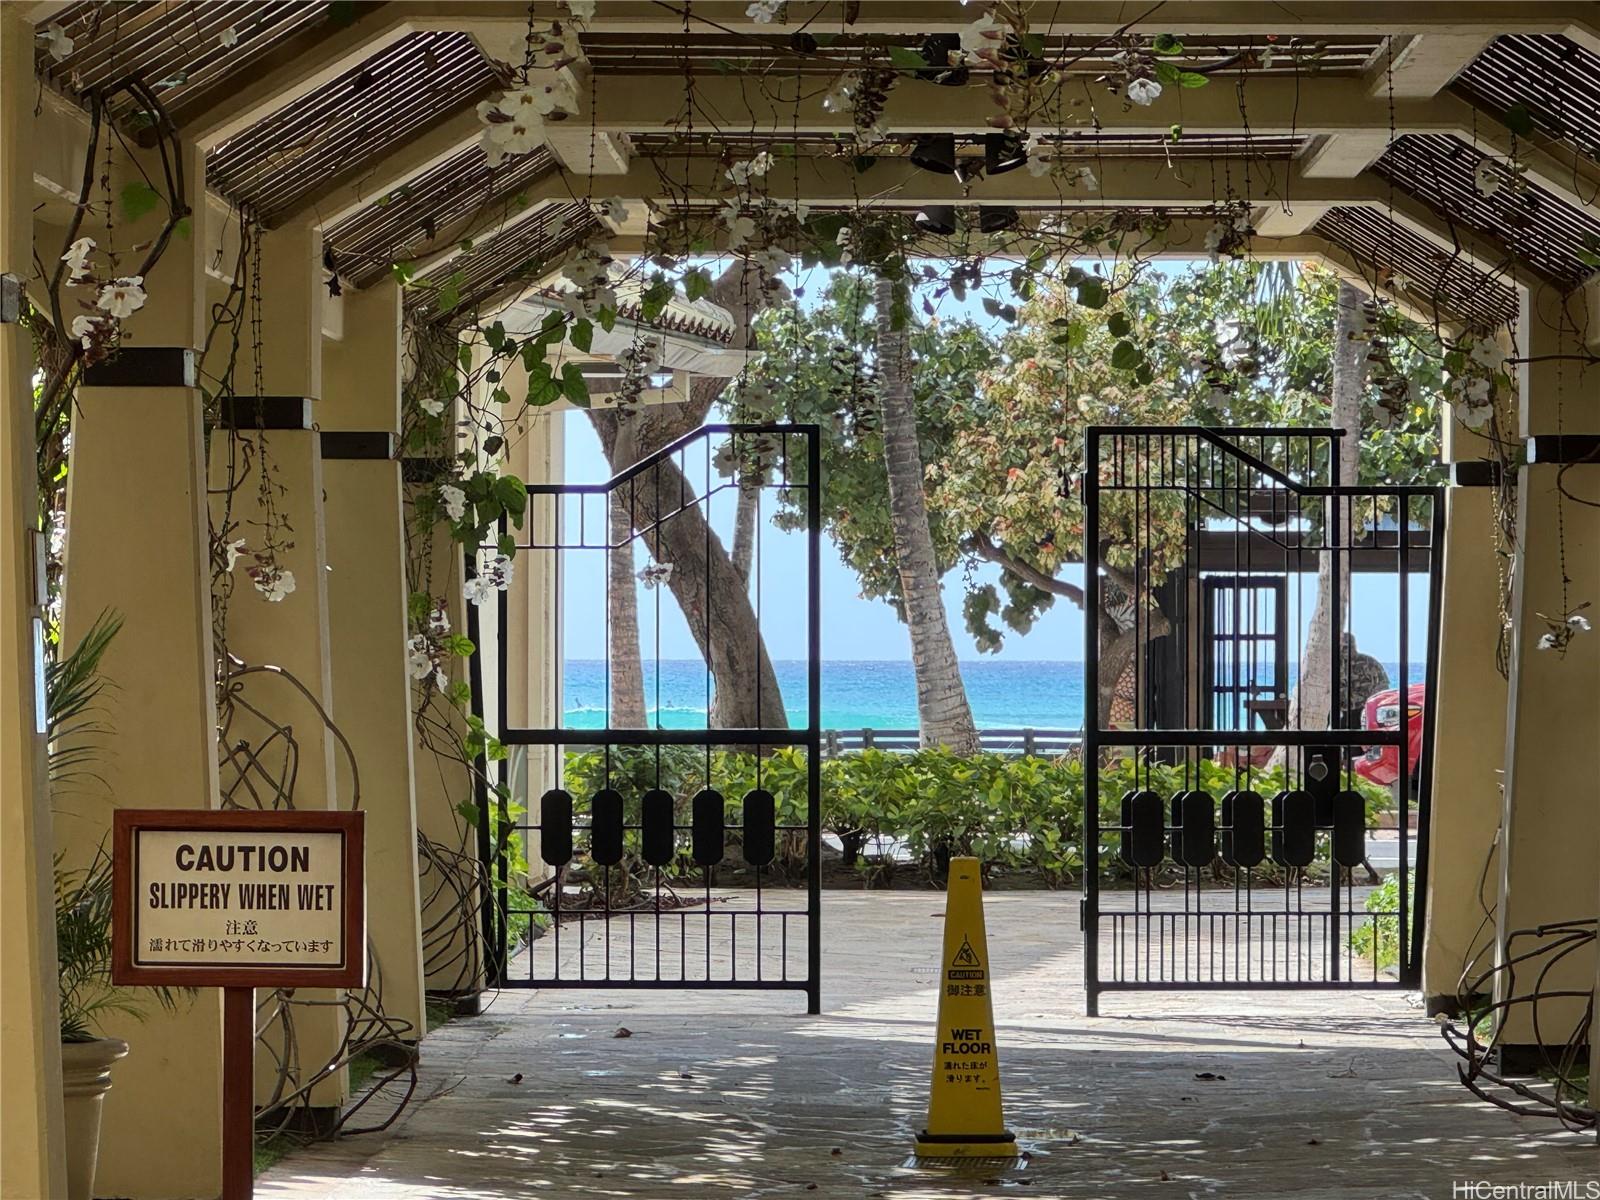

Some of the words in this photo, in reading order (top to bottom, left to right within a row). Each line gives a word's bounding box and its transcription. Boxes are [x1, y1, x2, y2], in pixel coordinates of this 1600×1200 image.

[175, 844, 310, 872] CAUTION
[149, 882, 231, 910] SLIPPERY
[239, 884, 290, 910] WHEN
[297, 884, 335, 911] WET
[225, 919, 258, 935] 注意
[149, 938, 334, 953] 濡れて滑りやすくなっています
[950, 971, 983, 979] CAUTION
[947, 984, 986, 996] 御注意
[951, 1029, 982, 1041] WET
[943, 1042, 991, 1054] FLOOR
